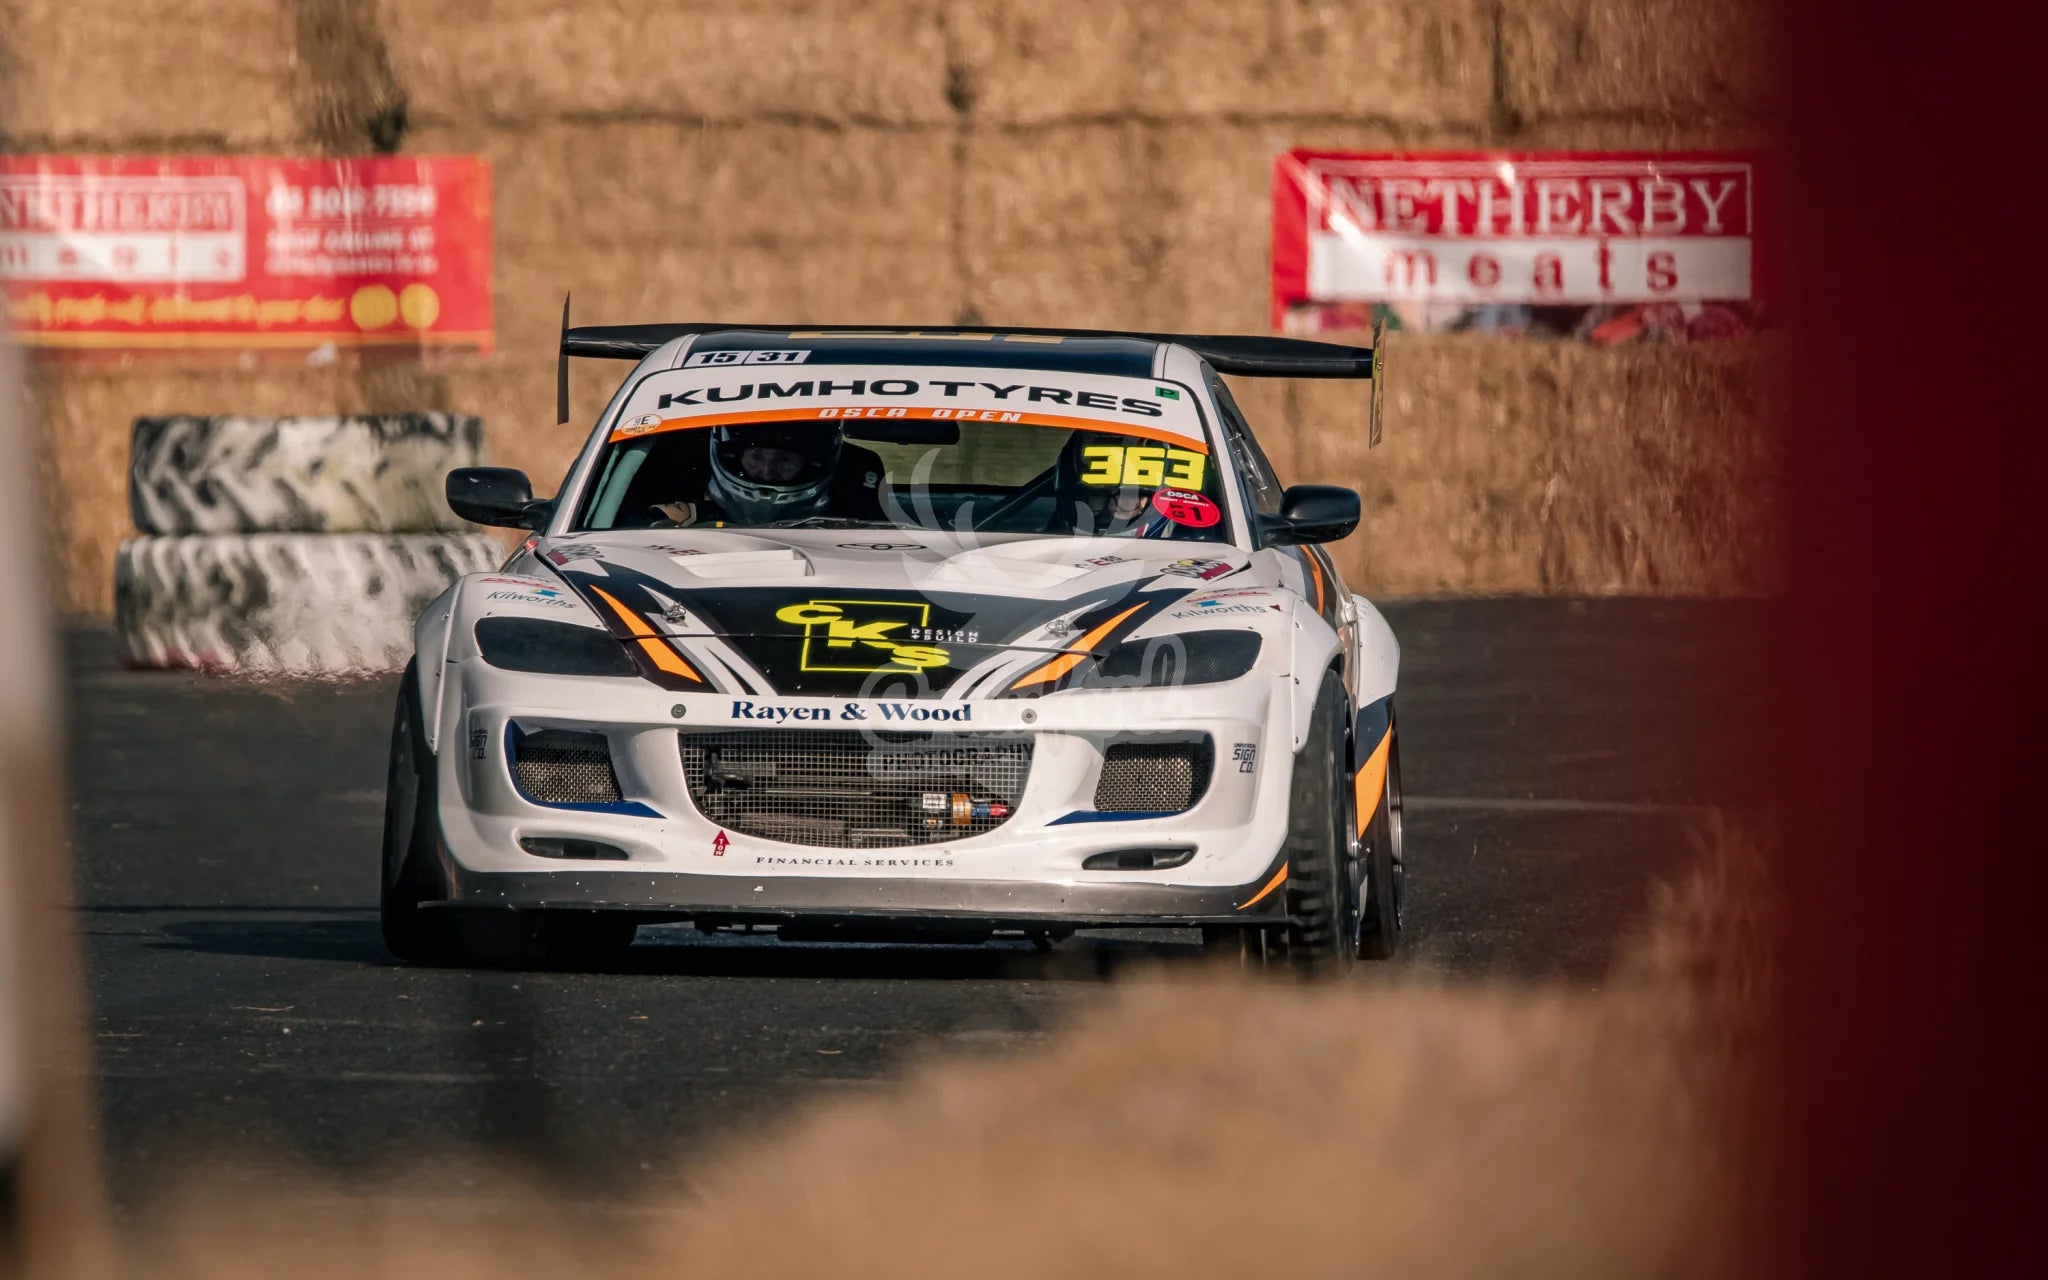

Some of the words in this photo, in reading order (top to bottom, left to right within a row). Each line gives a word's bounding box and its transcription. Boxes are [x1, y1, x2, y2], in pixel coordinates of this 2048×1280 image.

[1325, 175, 1736, 235] NETHERBY
[1382, 237, 1678, 293] meats
[699, 351, 739, 364] 15
[757, 351, 799, 363] 31
[657, 379, 920, 410] KUMHO
[928, 380, 1163, 418] TYRES
[818, 408, 909, 418] OSCA
[931, 408, 1023, 422] OPEN
[1081, 446, 1205, 491] 363
[1166, 491, 1199, 501] OSCA
[486, 591, 577, 609] Kilworths
[1171, 604, 1267, 619] Kilworths
[775, 604, 951, 668] CKS
[911, 627, 979, 638] DESIGN
[731, 701, 831, 723] Rayen
[840, 702, 868, 721] &
[878, 703, 972, 721] Wood
[1232, 748, 1256, 761] SIGN
[715, 838, 724, 856] TOW
[756, 857, 858, 866] FINANCIAL
[864, 859, 954, 867] SERVICES
